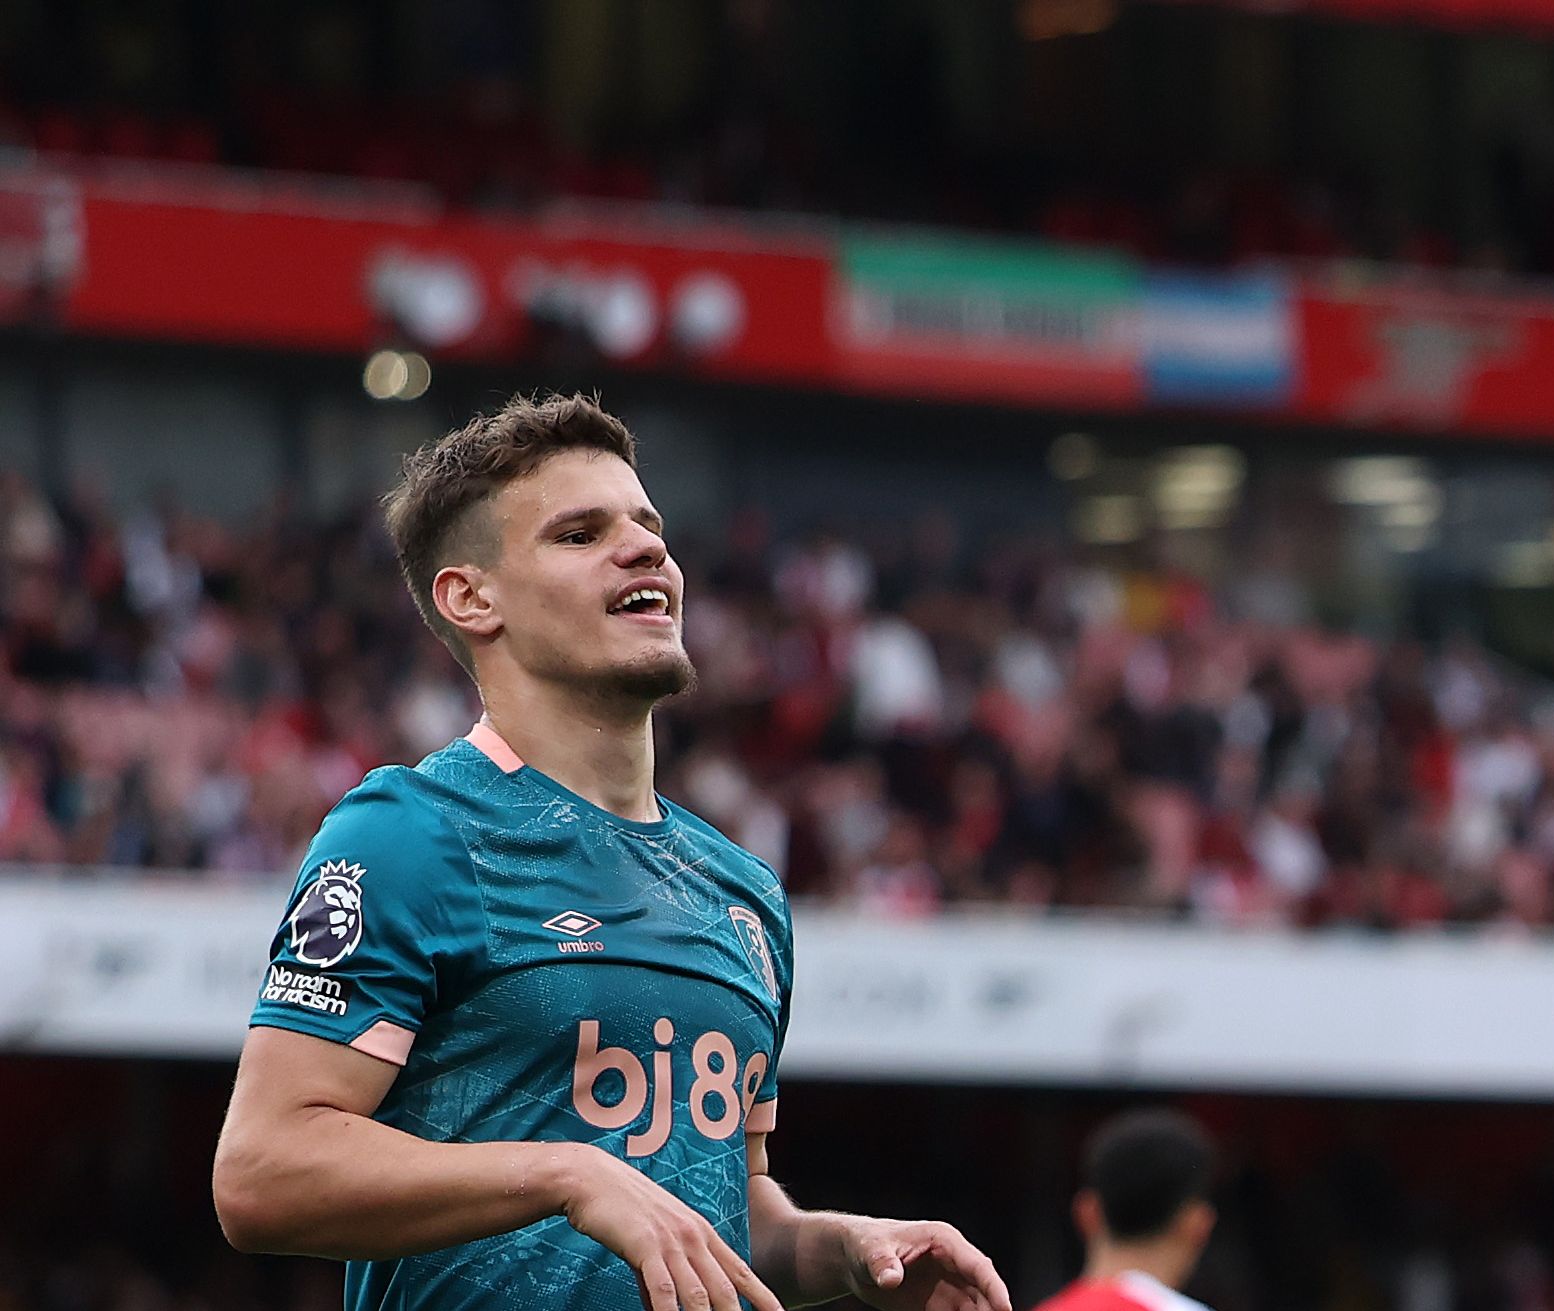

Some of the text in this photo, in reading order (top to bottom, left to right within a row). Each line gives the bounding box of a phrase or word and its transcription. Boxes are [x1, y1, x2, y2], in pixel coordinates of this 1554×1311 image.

[556, 939, 605, 954] umbro
[269, 964, 342, 998] No room
[261, 982, 347, 1016] for racism
